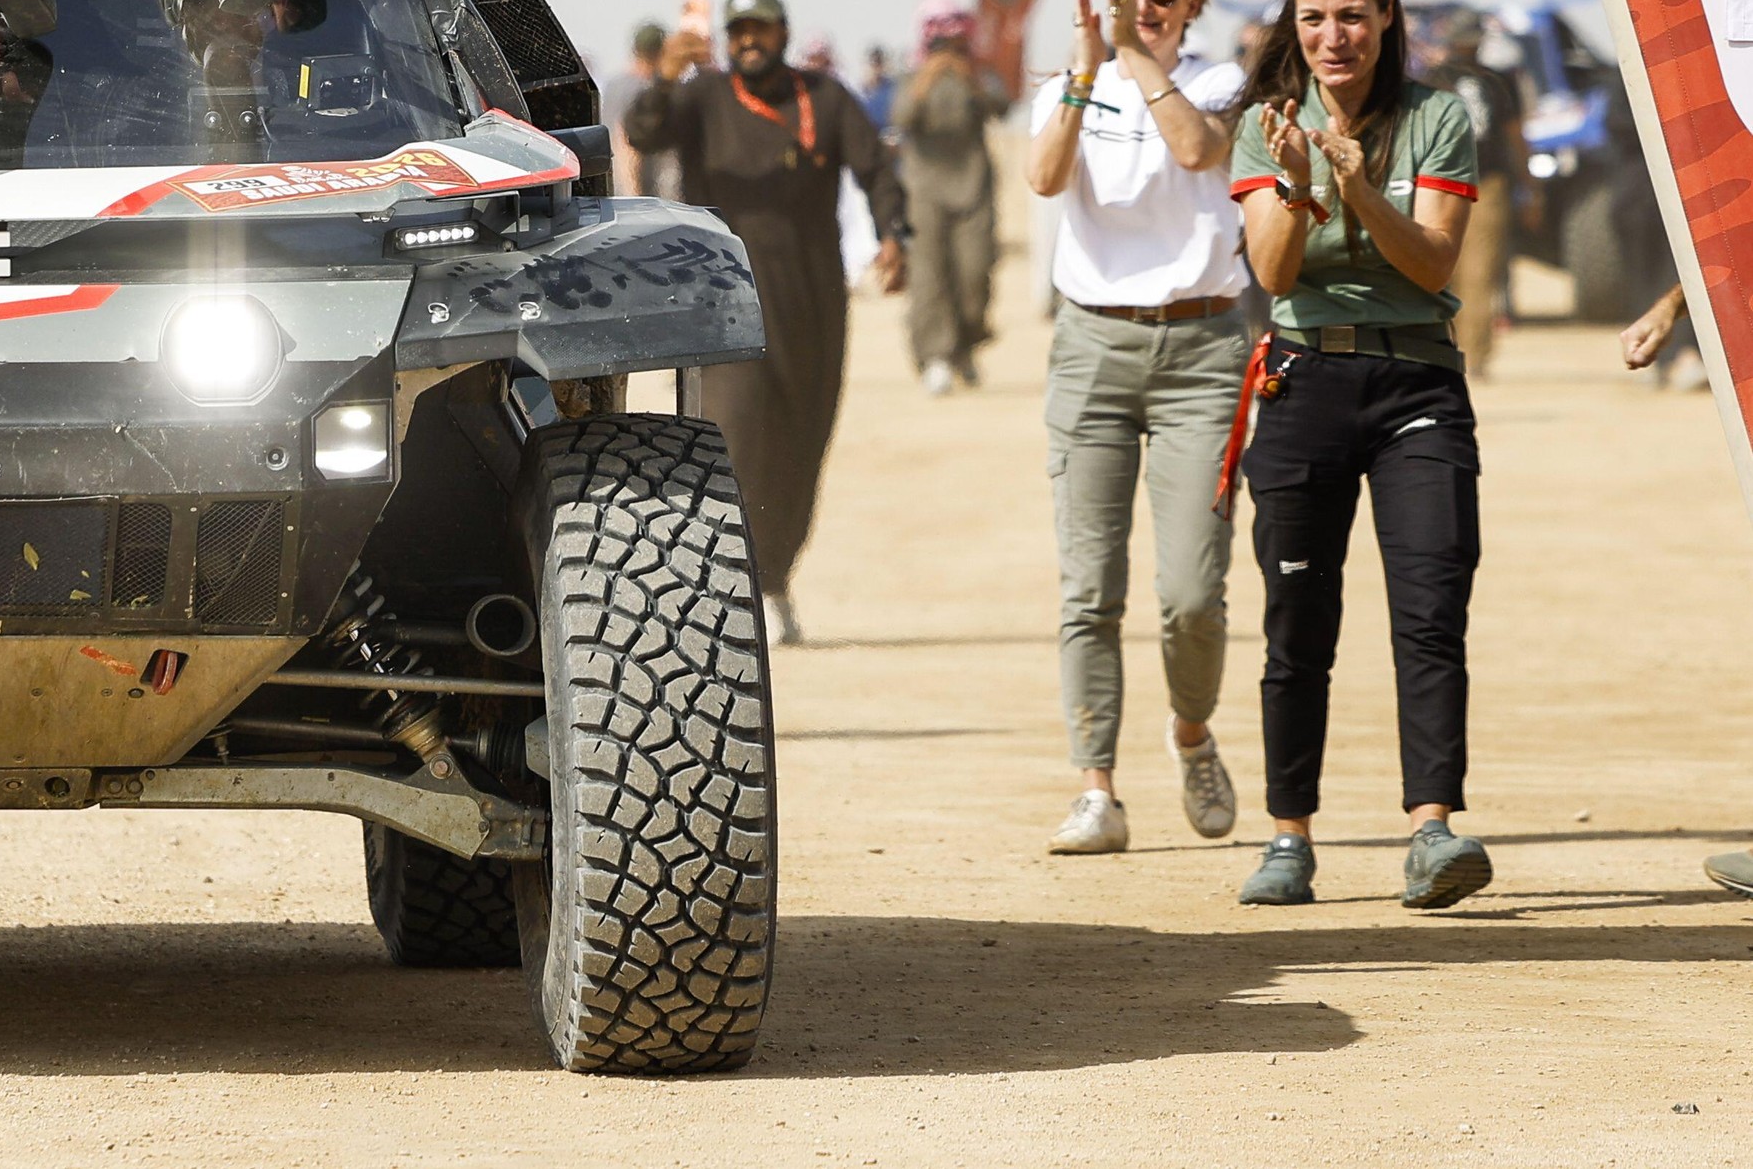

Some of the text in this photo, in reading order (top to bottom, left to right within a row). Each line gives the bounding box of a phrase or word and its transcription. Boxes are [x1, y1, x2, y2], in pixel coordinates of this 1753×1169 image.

[345, 151, 447, 179] 2026
[207, 178, 266, 191] 299
[240, 166, 429, 201] SAUDI ARABIA
